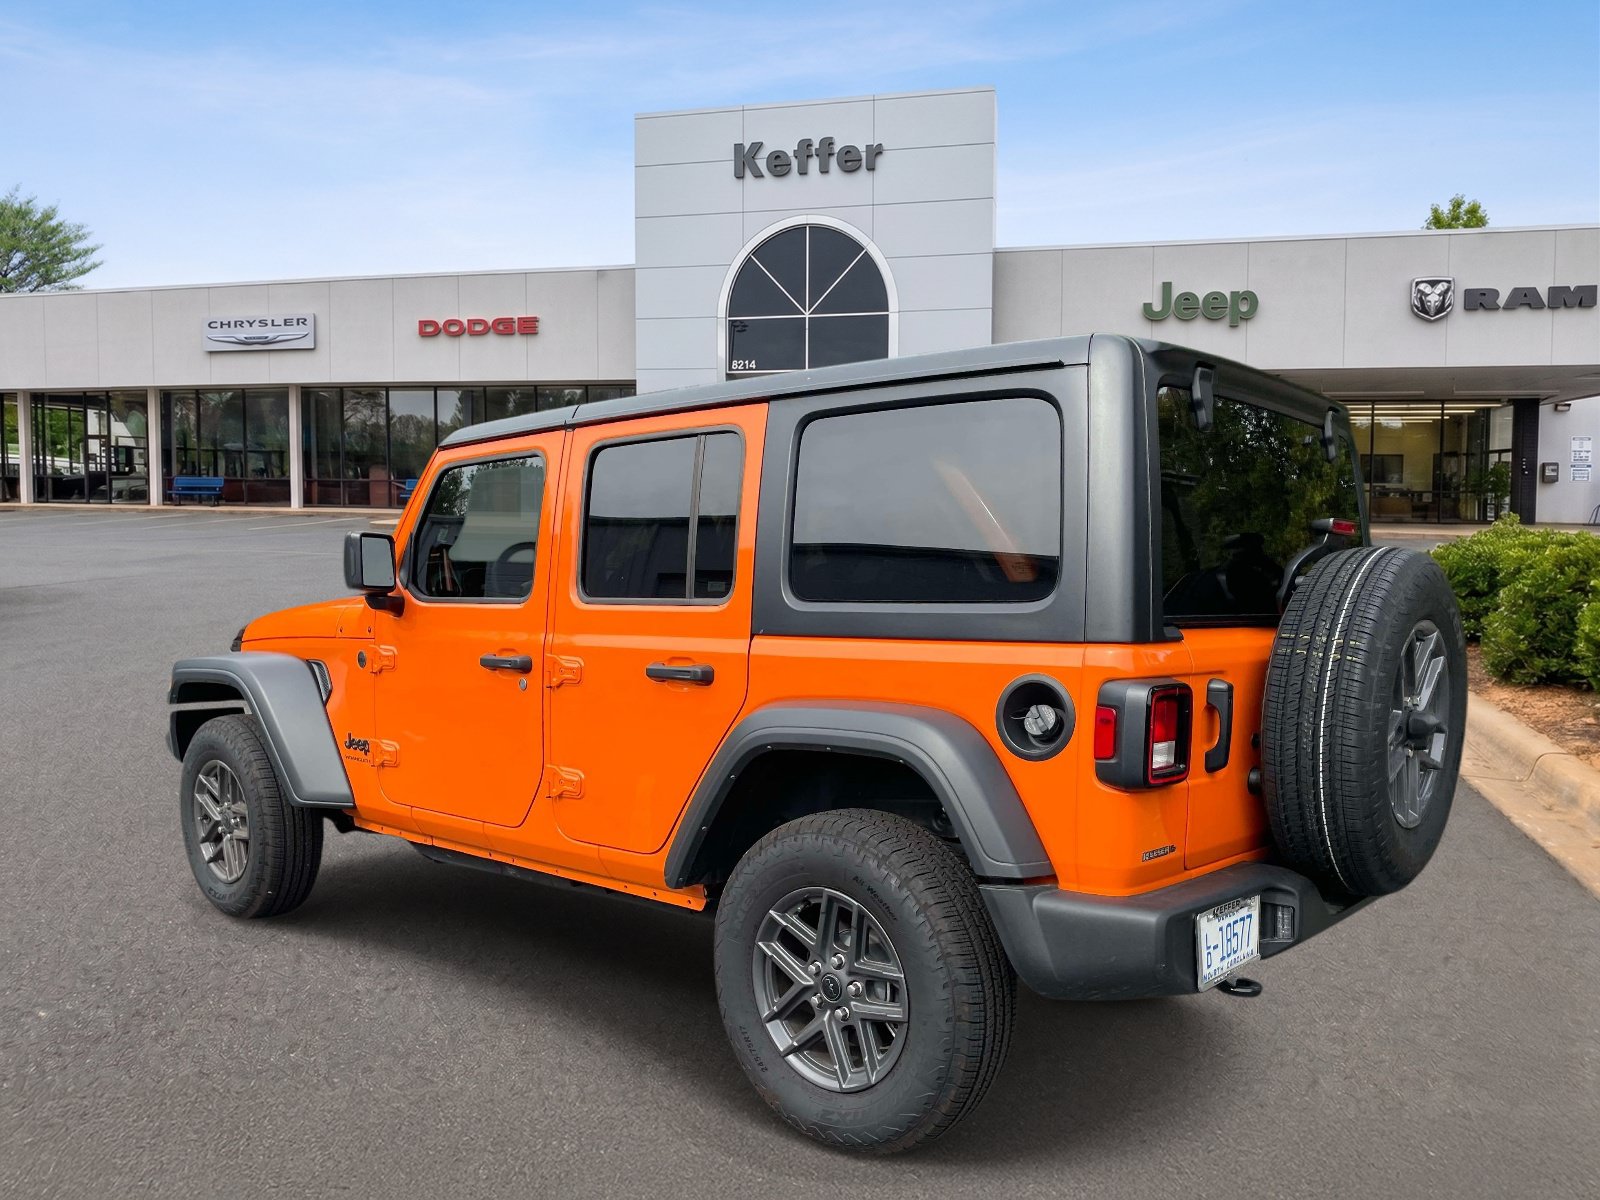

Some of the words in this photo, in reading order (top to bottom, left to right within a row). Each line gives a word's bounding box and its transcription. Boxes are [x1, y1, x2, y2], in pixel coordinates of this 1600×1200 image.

[733, 136, 884, 179] Keffer
[1142, 281, 1260, 328] Jeep
[1463, 284, 1598, 311] RAM
[207, 317, 308, 329] CHRYSLER
[418, 316, 539, 338] DODGE
[731, 359, 757, 370] 8214
[344, 732, 370, 756] Jeep
[1212, 900, 1241, 917] KEFFER
